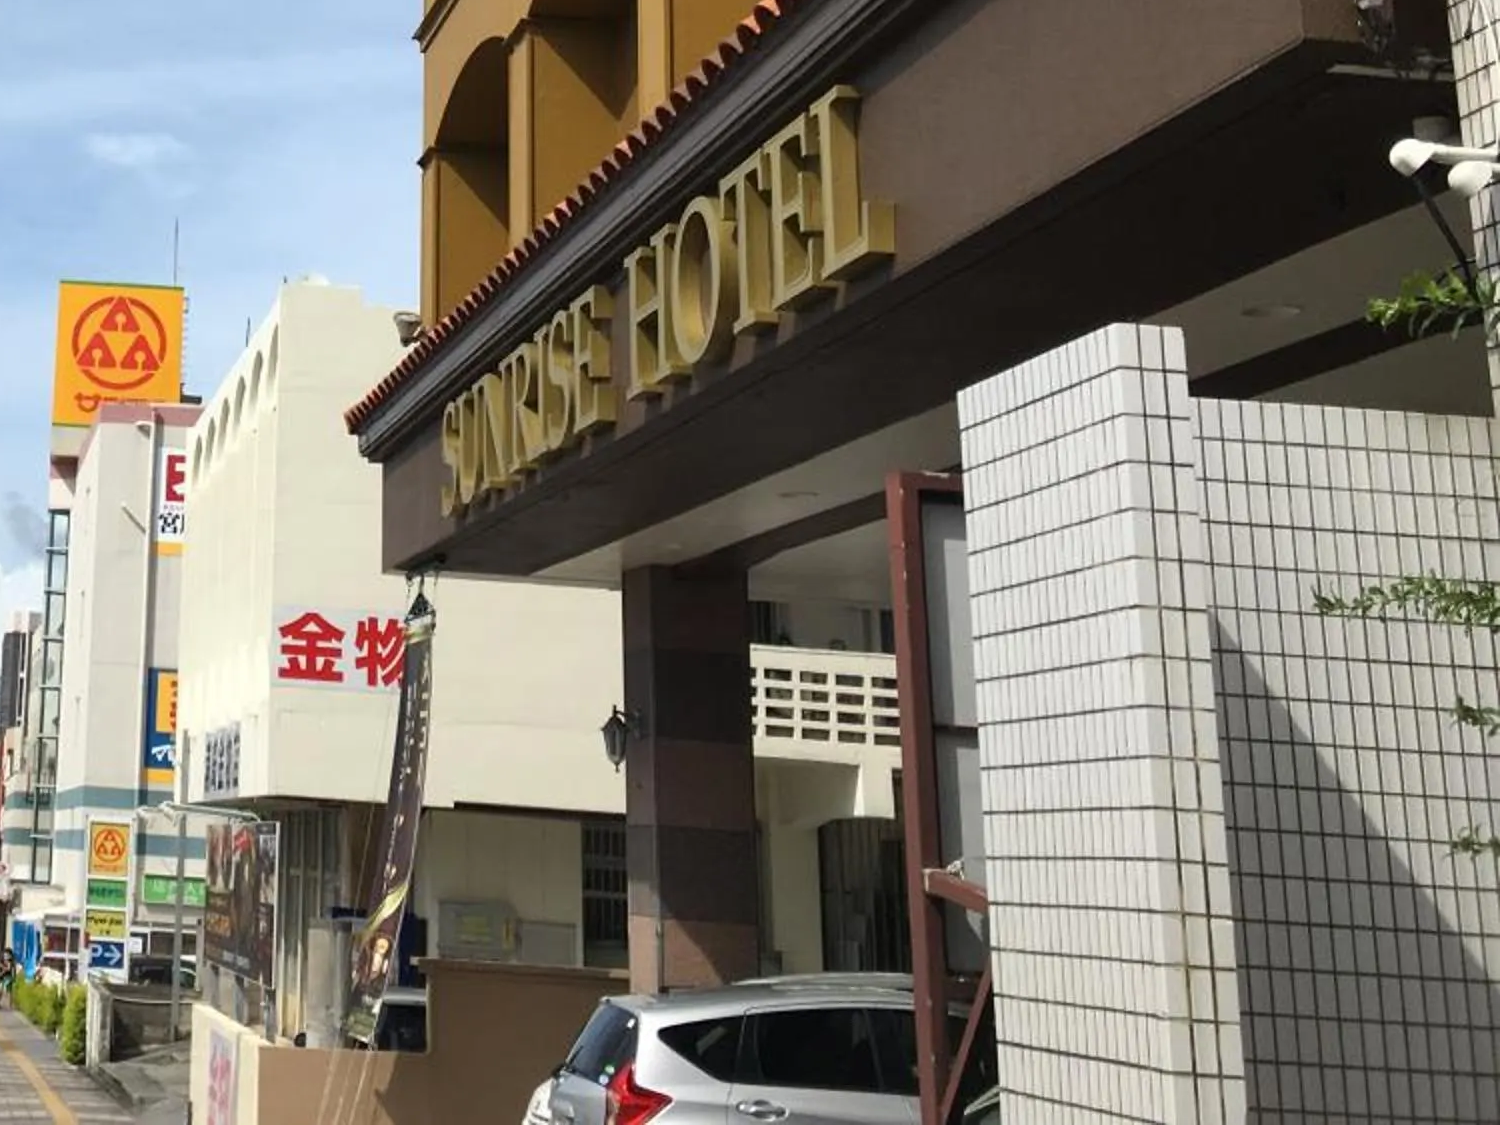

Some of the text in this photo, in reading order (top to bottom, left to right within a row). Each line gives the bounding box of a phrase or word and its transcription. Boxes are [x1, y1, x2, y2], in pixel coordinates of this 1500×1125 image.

[441, 84, 897, 518] SUNRISE HOTEL
[277, 611, 408, 687] 金物
